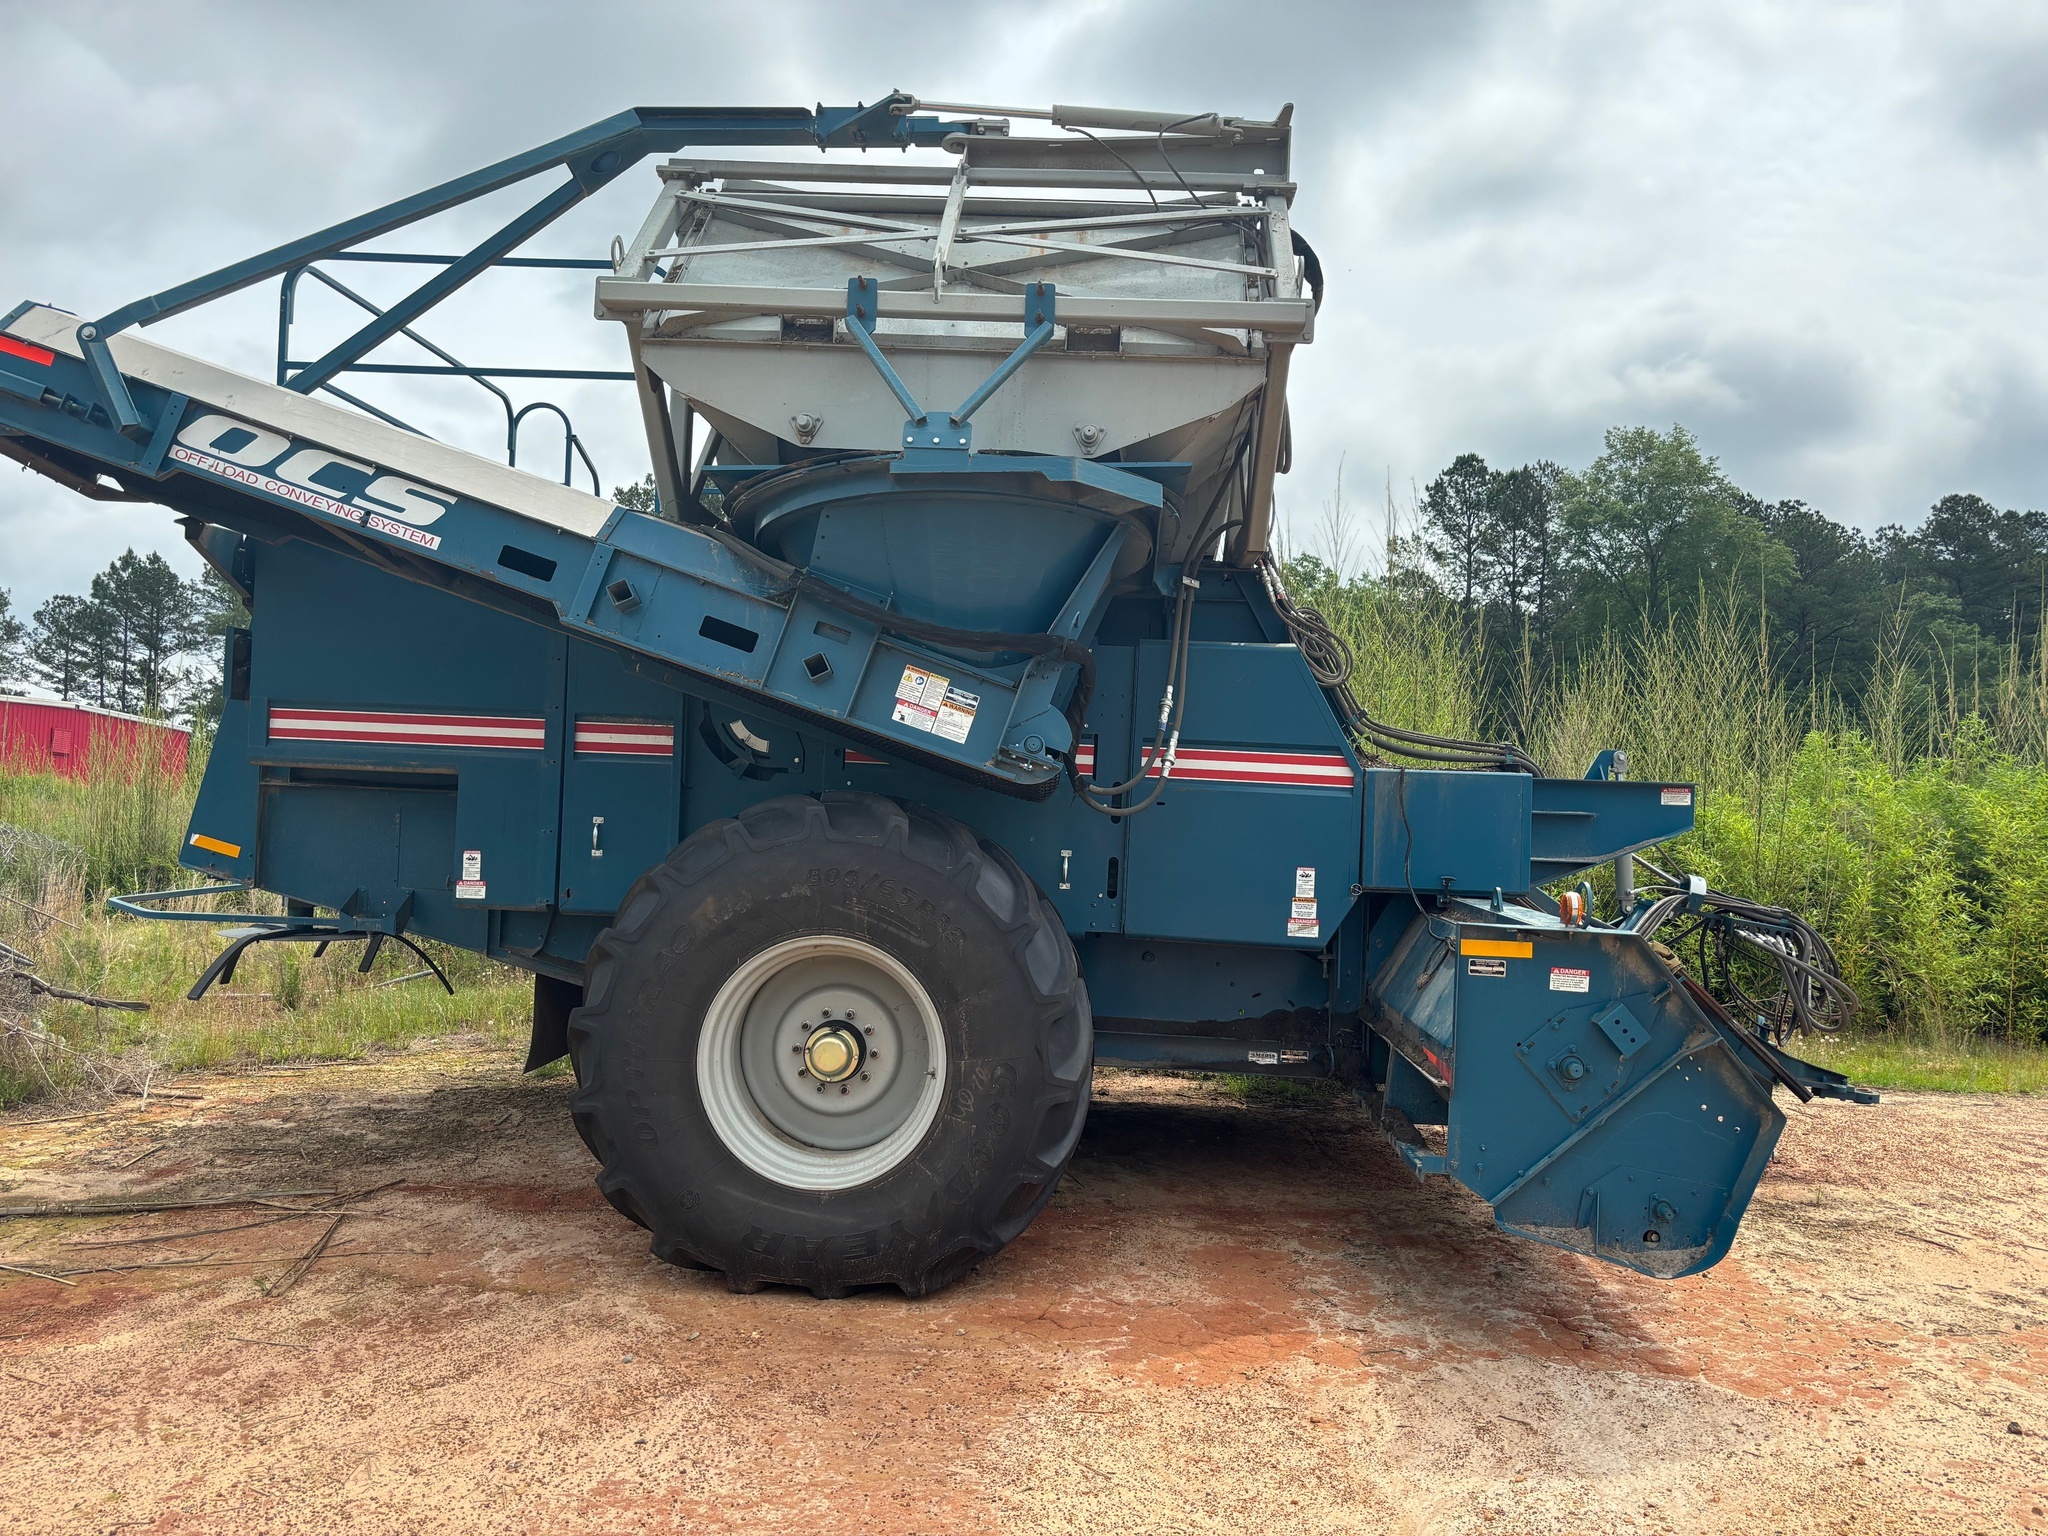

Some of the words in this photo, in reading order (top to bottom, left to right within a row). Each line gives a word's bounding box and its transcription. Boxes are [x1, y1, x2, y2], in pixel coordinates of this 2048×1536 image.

[177, 415, 458, 525] OCS
[265, 480, 363, 522] CONVEYING
[369, 516, 435, 547] SYSTEM
[909, 703, 932, 715] DANGER
[949, 704, 975, 716] WARNING
